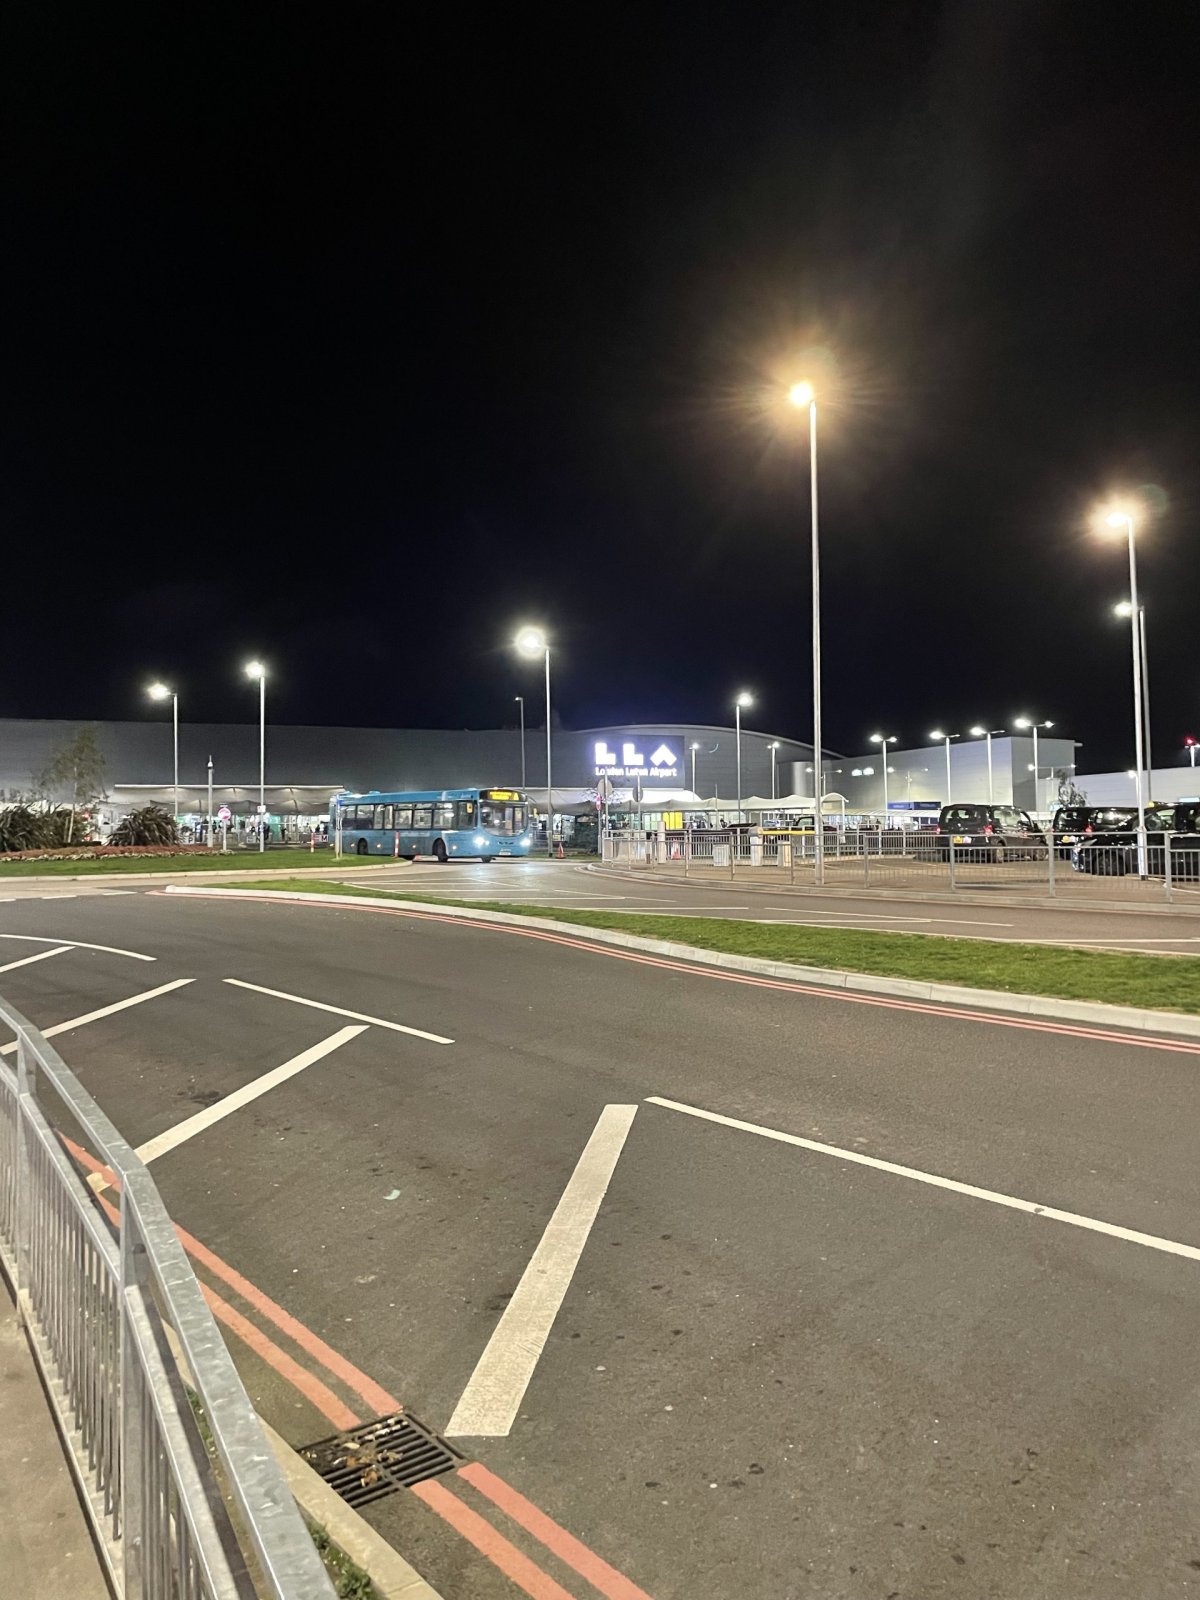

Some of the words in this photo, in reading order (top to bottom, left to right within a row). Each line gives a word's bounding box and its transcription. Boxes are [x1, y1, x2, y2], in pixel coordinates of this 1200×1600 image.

[595, 743, 677, 766] LLA
[625, 766, 648, 776] Luton
[649, 767, 677, 778] Airport
